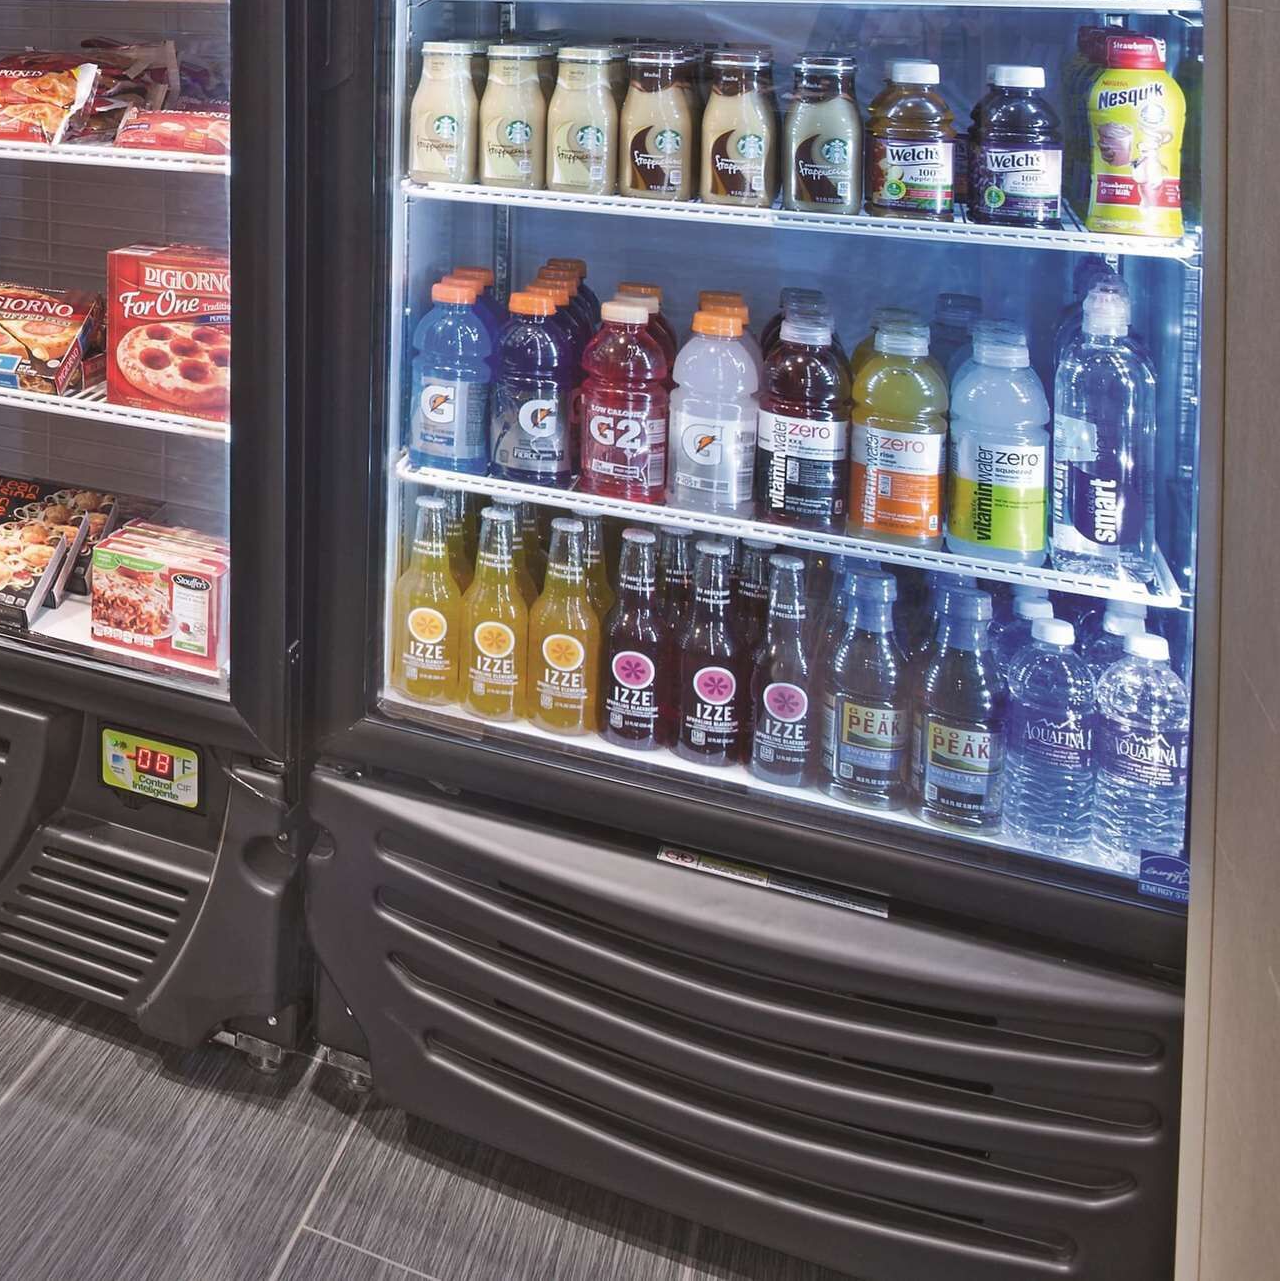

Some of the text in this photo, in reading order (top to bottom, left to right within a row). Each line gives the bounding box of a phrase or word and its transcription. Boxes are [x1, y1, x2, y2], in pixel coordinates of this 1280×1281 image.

[1112, 41, 1153, 53] Strawberry
[1097, 83, 1163, 110] Nesquik
[891, 145, 939, 162] Welch's
[991, 154, 1041, 168] Welch's
[119, 290, 199, 318] For One
[421, 385, 455, 423] G
[518, 399, 557, 437] G
[590, 415, 641, 448] G2
[788, 423, 830, 439] zero
[881, 436, 924, 453] zero
[769, 418, 787, 509] vitaminwater
[995, 452, 1039, 466] zero
[0, 480, 40, 493] Lean
[974, 446, 993, 541] vitaminwater
[1090, 479, 1117, 542] smart
[410, 641, 444, 659] IZZE
[477, 656, 512, 673] IZZE
[545, 669, 580, 687] IZZE
[614, 686, 652, 706] IZZE
[696, 703, 732, 721] IZZE
[765, 719, 804, 739] IZZE
[849, 715, 899, 735] PEAK
[933, 735, 989, 759] PEAK
[139, 775, 173, 790] Control
